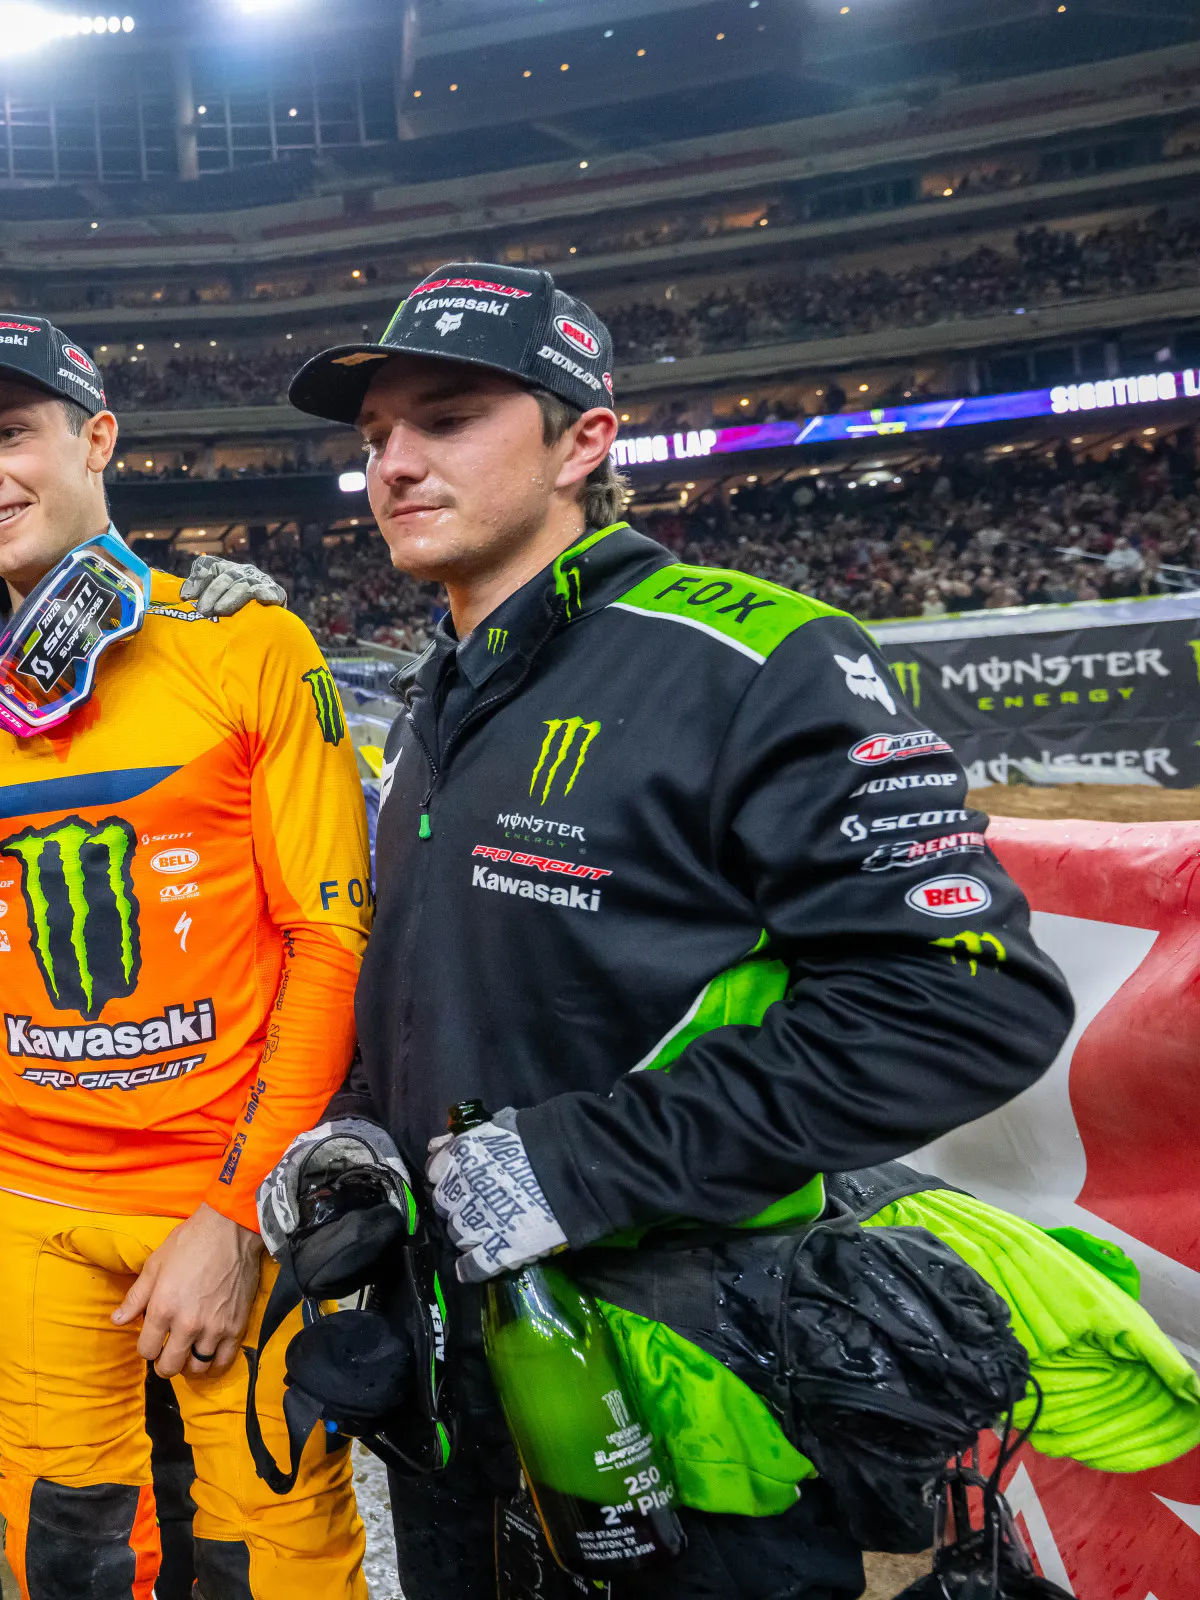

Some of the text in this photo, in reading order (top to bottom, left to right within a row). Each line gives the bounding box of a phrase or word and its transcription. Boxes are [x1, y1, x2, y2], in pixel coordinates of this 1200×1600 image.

[409, 278, 532, 300] PRO CIRCUIT
[414, 297, 510, 317] Kawasaki
[563, 321, 596, 352] BELL
[537, 345, 601, 391] DUNLOP
[1050, 372, 1176, 413] SIGHTING
[674, 428, 717, 459] LAP
[42, 602, 61, 629] 2026
[654, 576, 776, 624] FOX
[43, 582, 93, 656] SCOTT
[59, 596, 104, 659] SUPERCROSS
[942, 649, 1170, 692] MONSTER
[978, 687, 1134, 711] ENERGY
[151, 832, 194, 841] SCOTT
[497, 812, 586, 842] MONSTER
[505, 831, 567, 848] ENERGY
[158, 854, 192, 867] BELL
[472, 845, 613, 880] PRO CIRCUIT
[472, 865, 601, 912] Kawasaki
[923, 886, 982, 907] BELL
[5, 1003, 213, 1058] Kawasaki
[20, 1056, 204, 1089] PRO CIRCUIT
[624, 1465, 661, 1496] 250
[600, 1500, 634, 1526] 2nd
[597, 1526, 636, 1539] STADIUM
